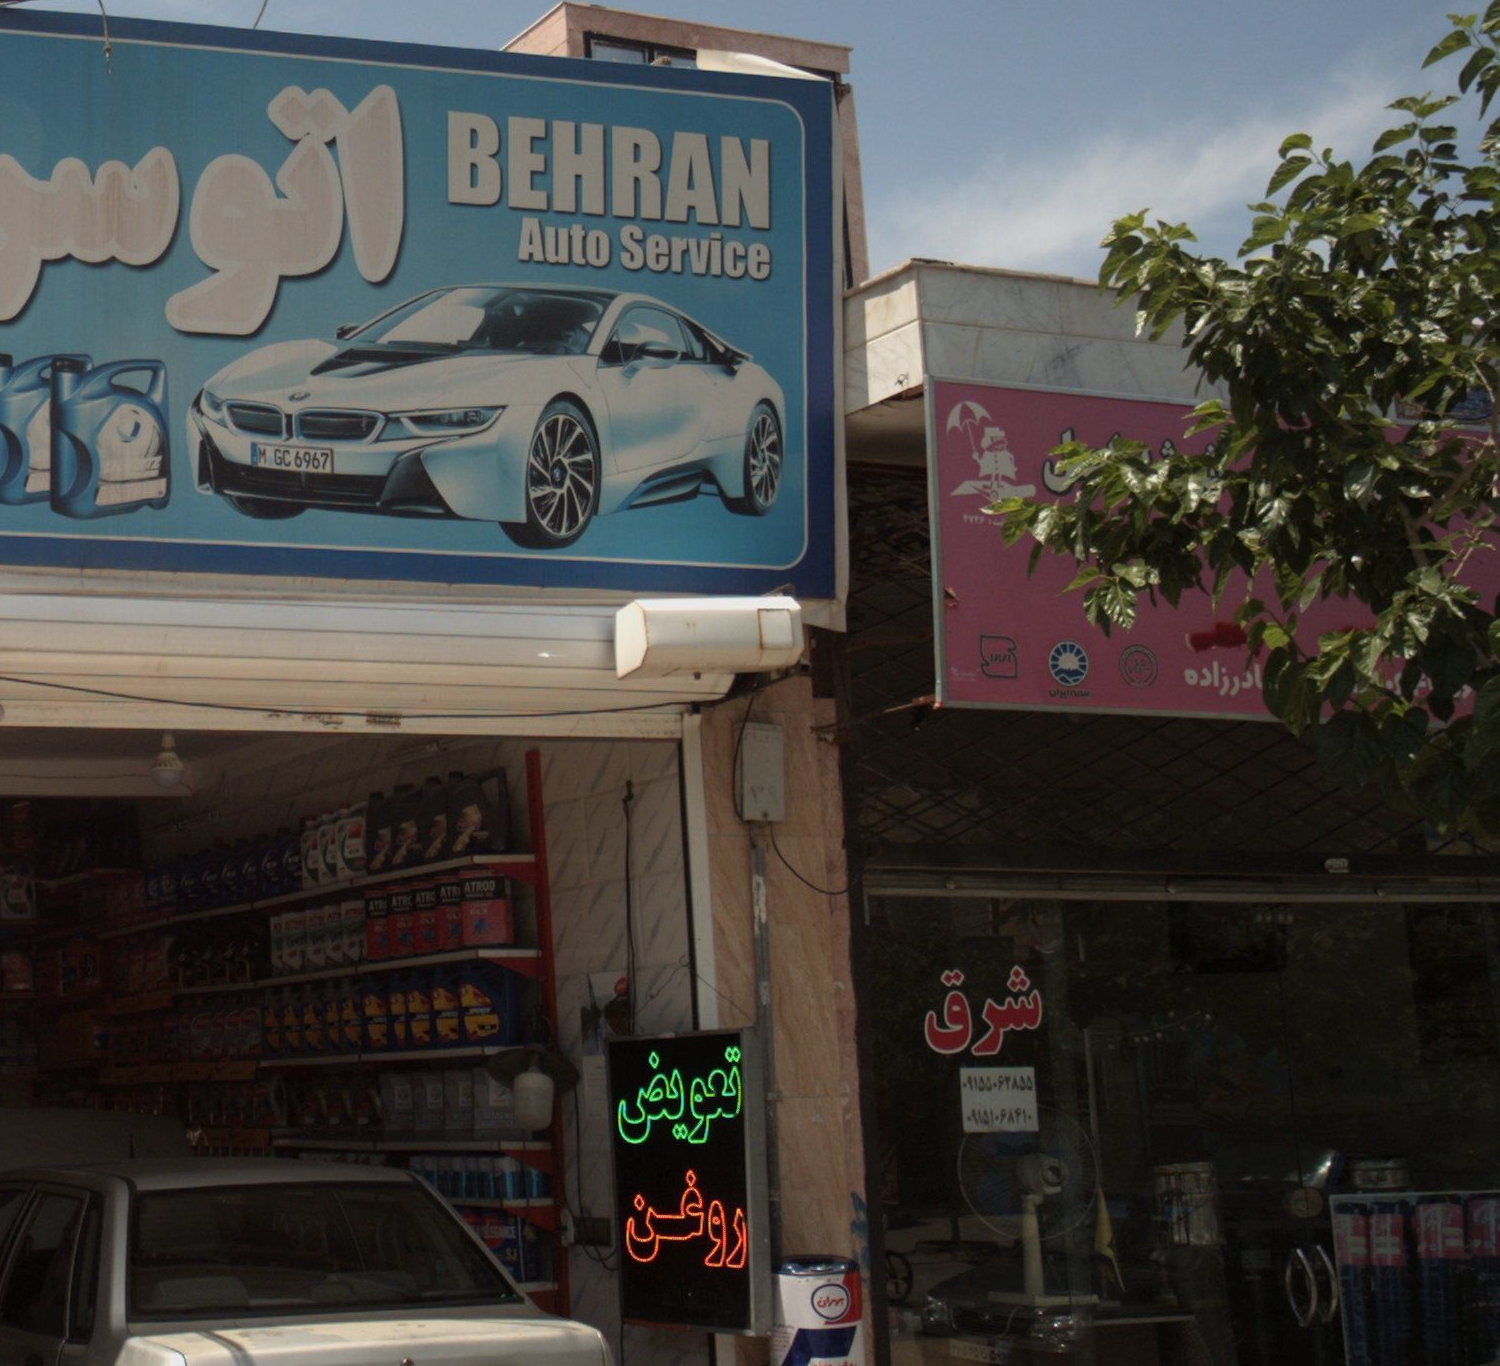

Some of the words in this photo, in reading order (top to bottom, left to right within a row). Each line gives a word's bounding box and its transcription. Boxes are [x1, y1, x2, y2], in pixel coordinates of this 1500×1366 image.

[448, 110, 771, 229] BEHRAN
[519, 216, 609, 266] Auto
[620, 224, 772, 280] Service
[293, 449, 329, 470] 6967
[1183, 660, 1264, 696] ادرزاده
[924, 966, 1043, 1055] شرق
[617, 1045, 742, 1144] تعویض
[625, 1169, 748, 1269] روغن
